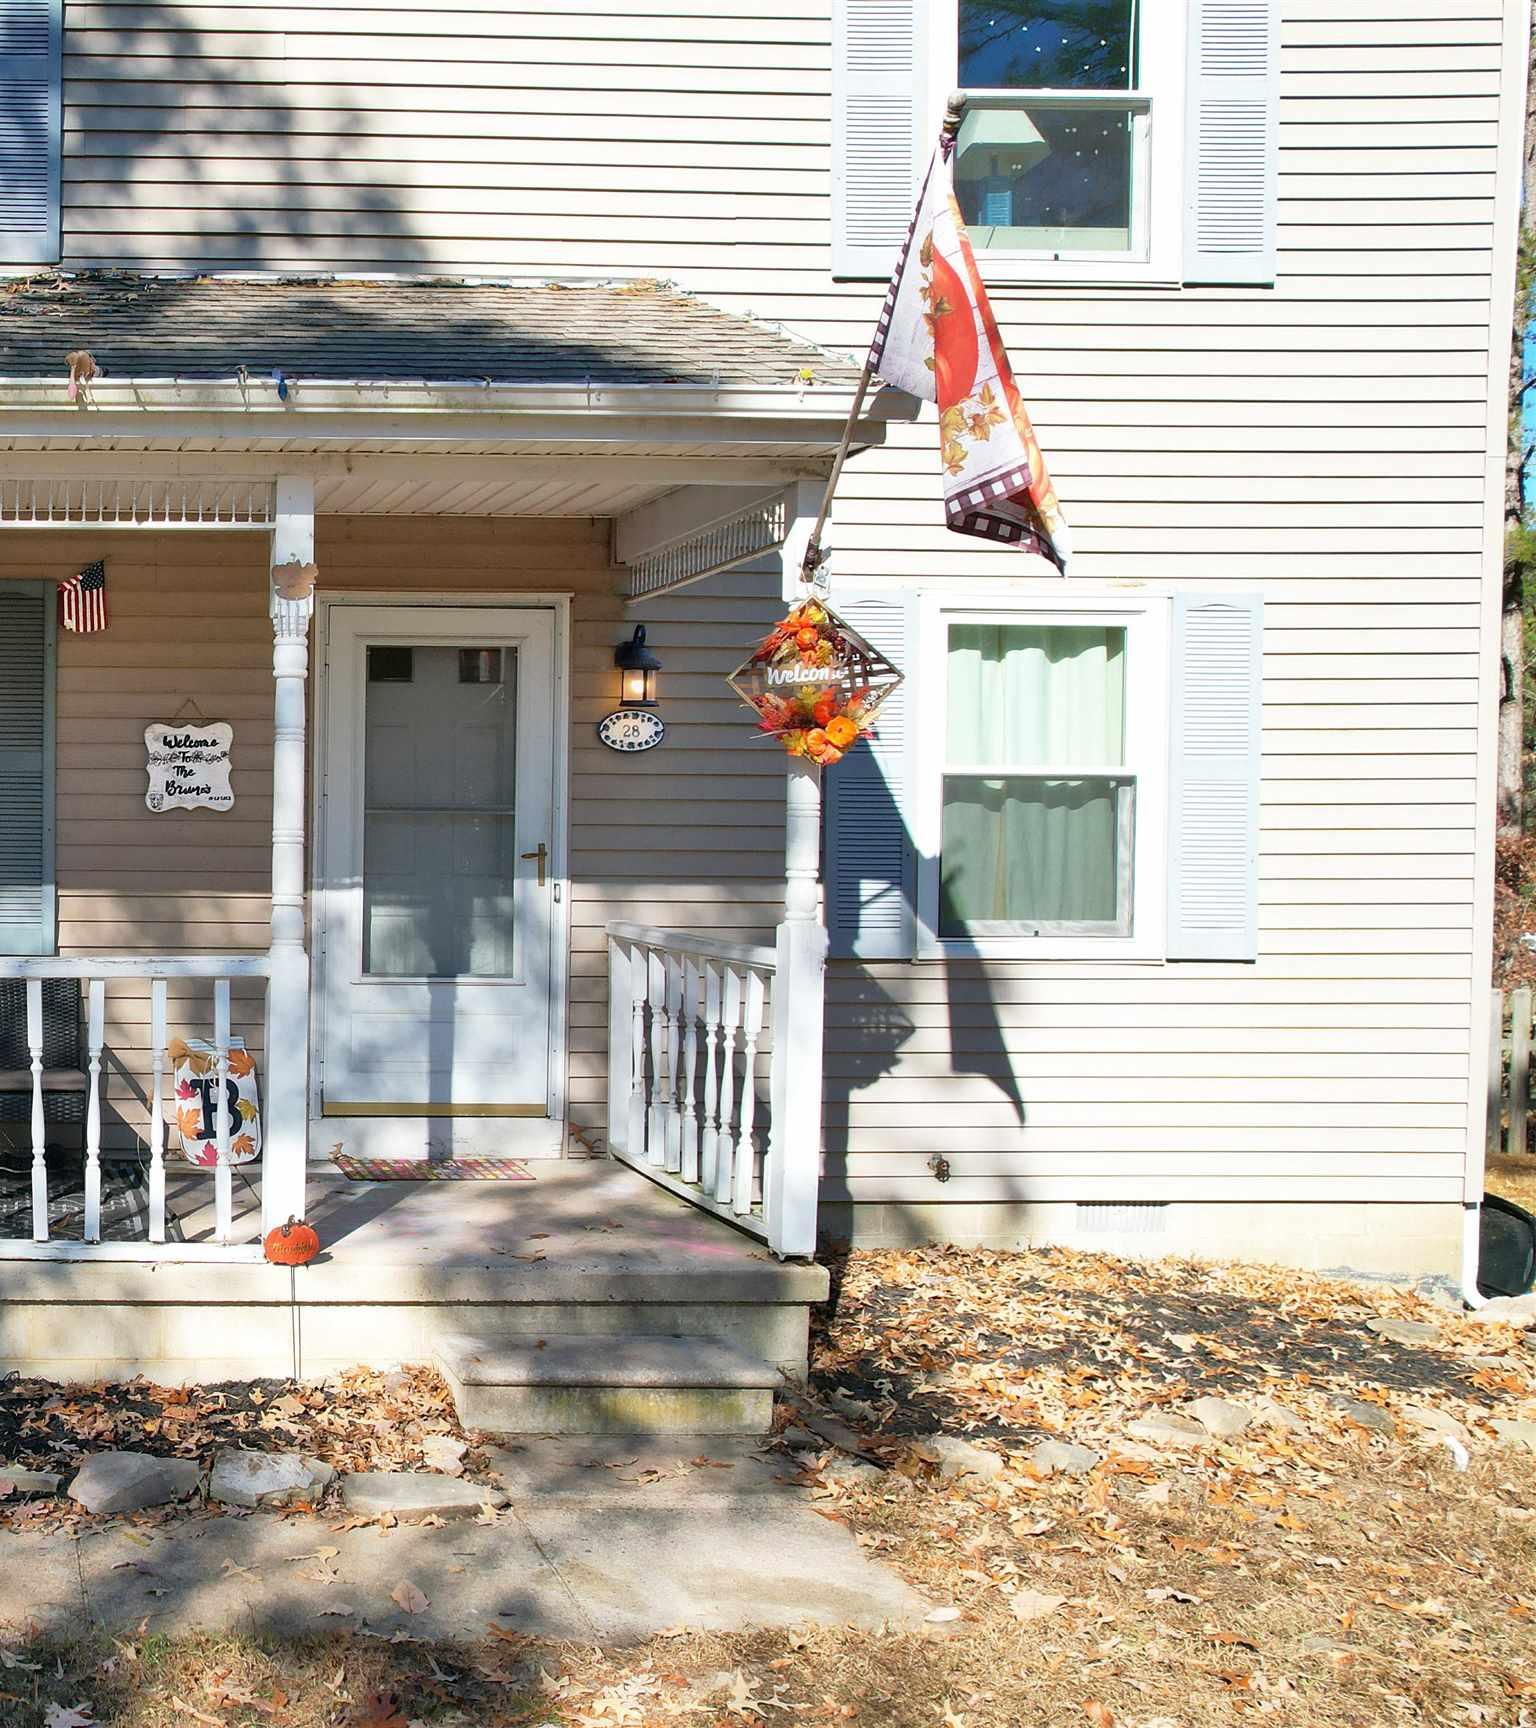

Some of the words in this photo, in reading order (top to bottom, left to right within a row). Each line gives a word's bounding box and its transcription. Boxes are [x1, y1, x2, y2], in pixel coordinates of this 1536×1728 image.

[767, 664, 845, 685] Welcome
[623, 725, 640, 737] 28
[163, 734, 219, 748] Welcome
[178, 751, 191, 763] To
[172, 765, 196, 778] The
[190, 1078, 243, 1140] B
